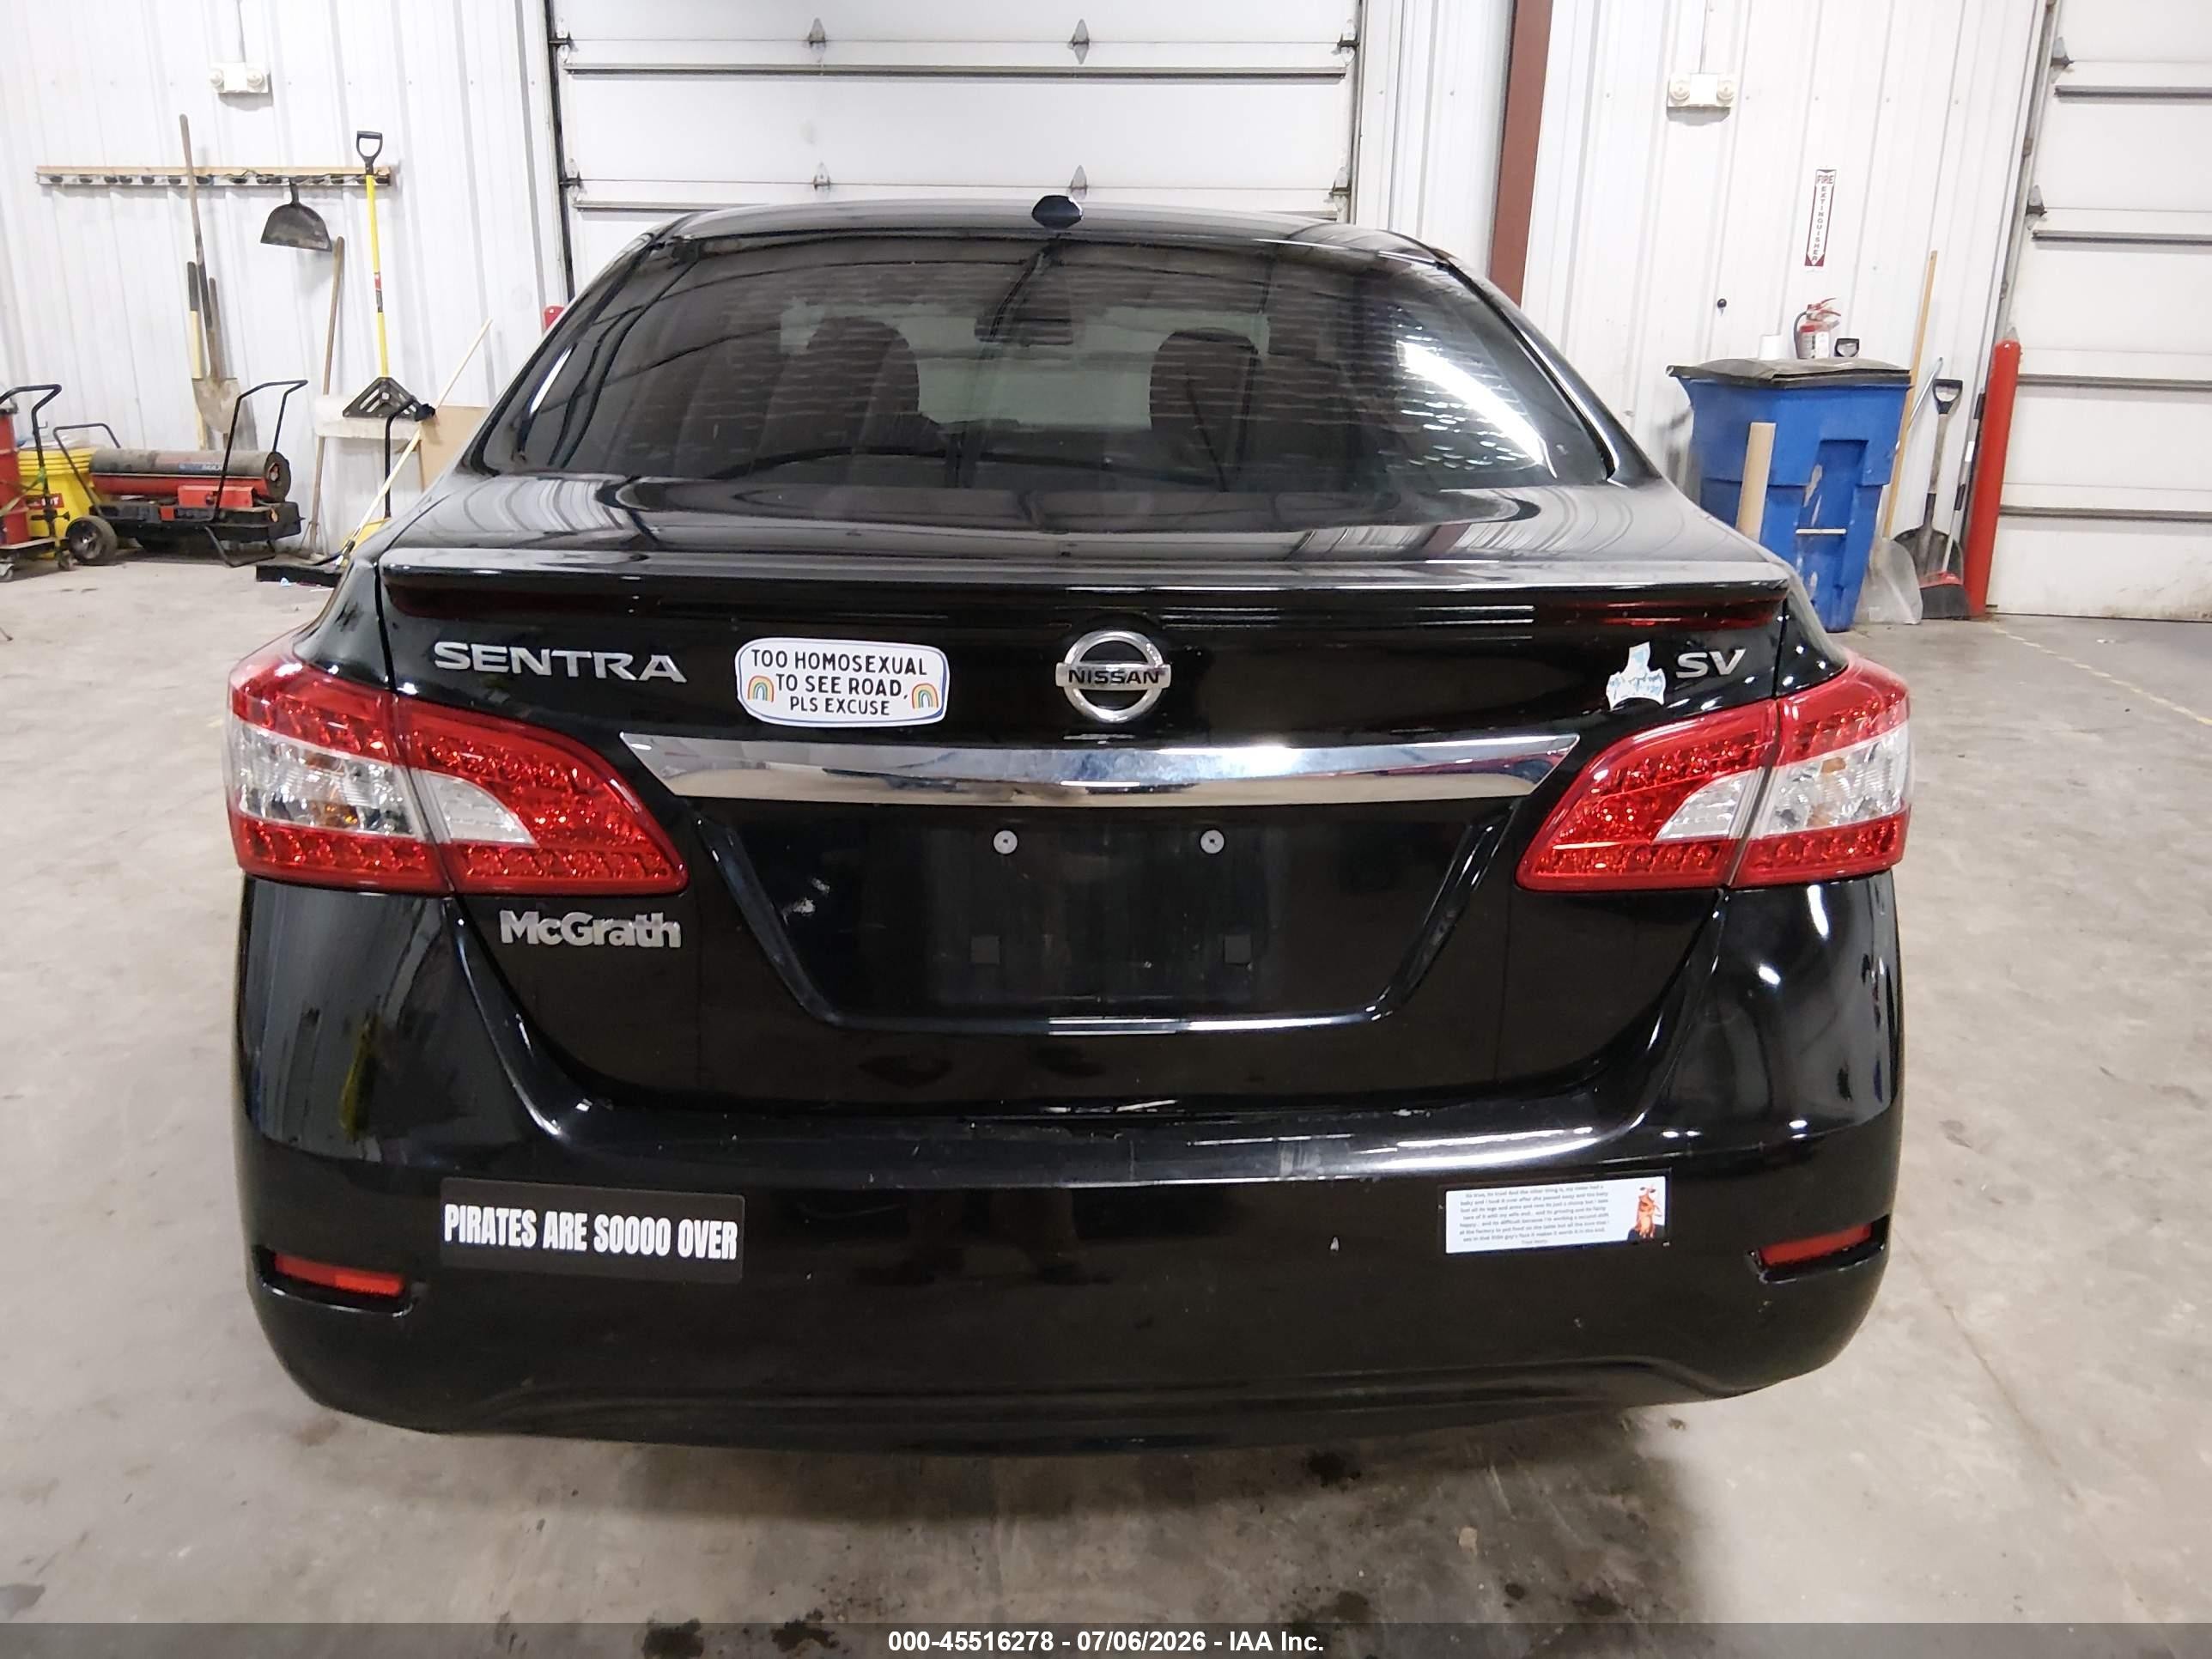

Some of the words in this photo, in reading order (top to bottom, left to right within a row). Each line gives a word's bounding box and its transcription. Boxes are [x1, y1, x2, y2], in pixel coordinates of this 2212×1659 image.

[1816, 174, 1835, 185] FIRE
[1812, 185, 1827, 262] EXTINGUISHER
[434, 641, 687, 683] SENTRA
[751, 649, 788, 668] TOO
[794, 651, 927, 676] HOMOSEXUAL
[1675, 648, 1747, 678] SV
[775, 674, 798, 691] TO
[805, 676, 842, 695] SEE
[848, 678, 908, 700] ROAD,
[1068, 670, 1160, 684] NISSAN
[790, 696, 818, 712] PLS
[824, 698, 890, 716] EXCUSE
[499, 910, 681, 948] McGrath
[444, 1204, 537, 1248] PIRATES
[542, 1212, 587, 1251] ARE
[593, 1214, 672, 1257] SOOOO
[678, 1218, 738, 1261] OVER
